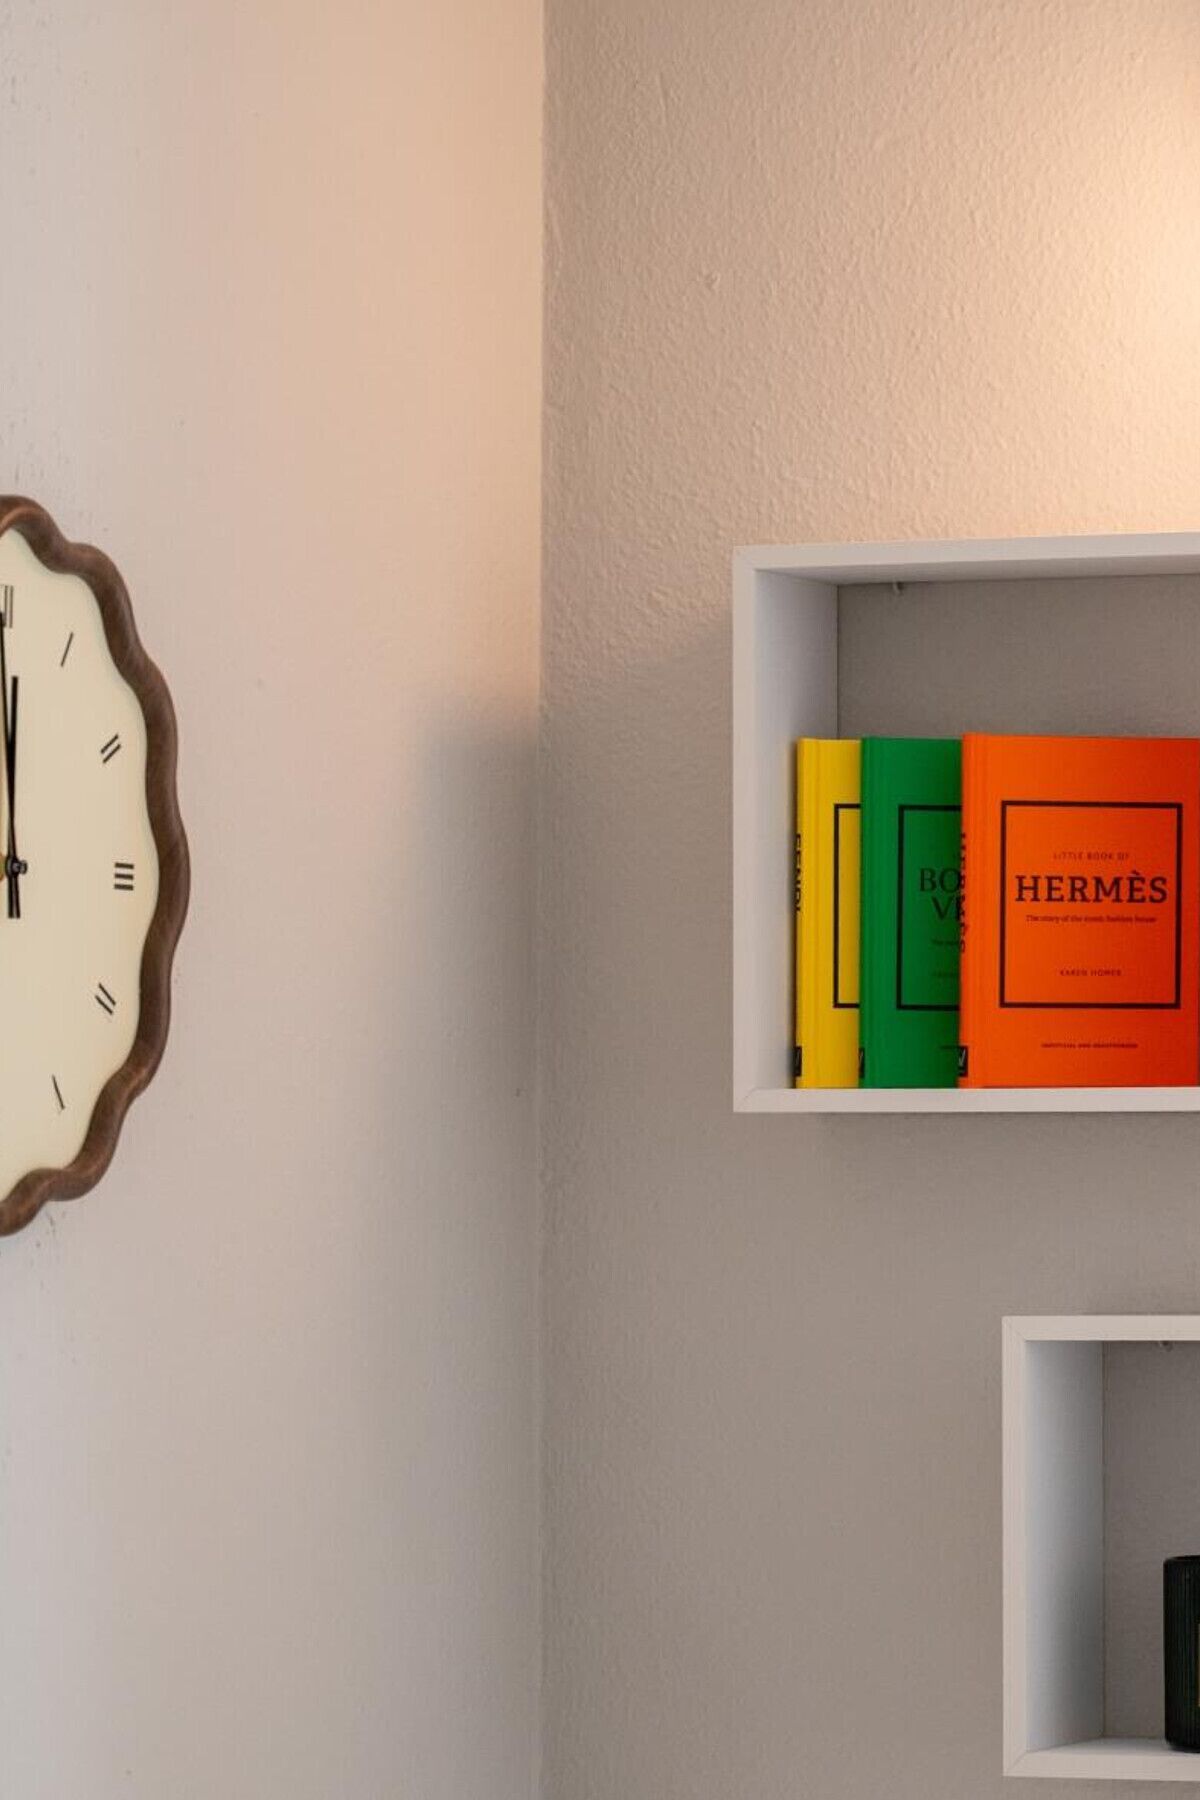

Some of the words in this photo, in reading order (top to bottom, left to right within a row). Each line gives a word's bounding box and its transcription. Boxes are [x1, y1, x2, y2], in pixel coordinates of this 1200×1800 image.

[1053, 852, 1083, 860] LITTLE
[1087, 852, 1113, 861] BOOK
[1015, 870, 1168, 903] HERMÈS
